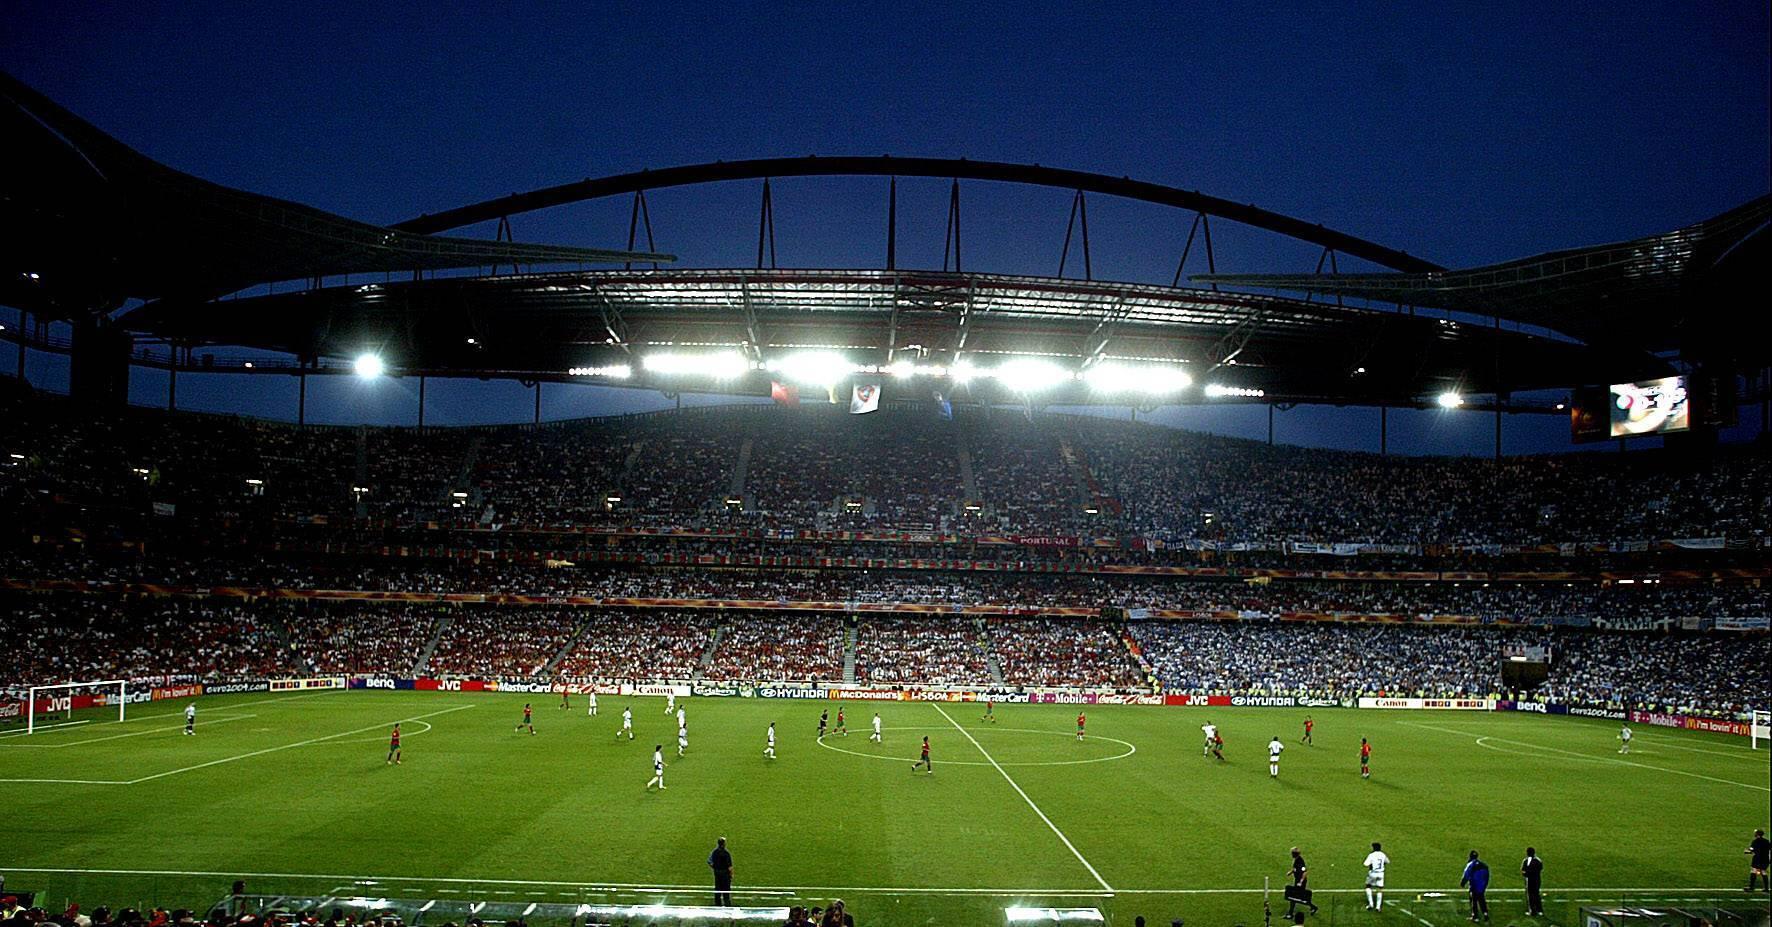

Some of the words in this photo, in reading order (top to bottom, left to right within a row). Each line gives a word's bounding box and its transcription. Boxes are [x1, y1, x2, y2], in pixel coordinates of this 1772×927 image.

[366, 679, 396, 689] BenQ
[437, 680, 461, 691] JVC
[498, 682, 552, 693] MasterCard
[638, 686, 674, 695] Canon
[776, 689, 828, 699] HYUNDAI
[840, 690, 898, 700] McDonald's
[106, 689, 152, 705] MaserCard
[976, 692, 1030, 702] MasterCard
[1185, 696, 1209, 706] JVC
[1246, 697, 1295, 707] HYUNDAI
[47, 697, 70, 712] JVC
[1375, 699, 1407, 707] Canon
[1516, 701, 1547, 713] BenQ
